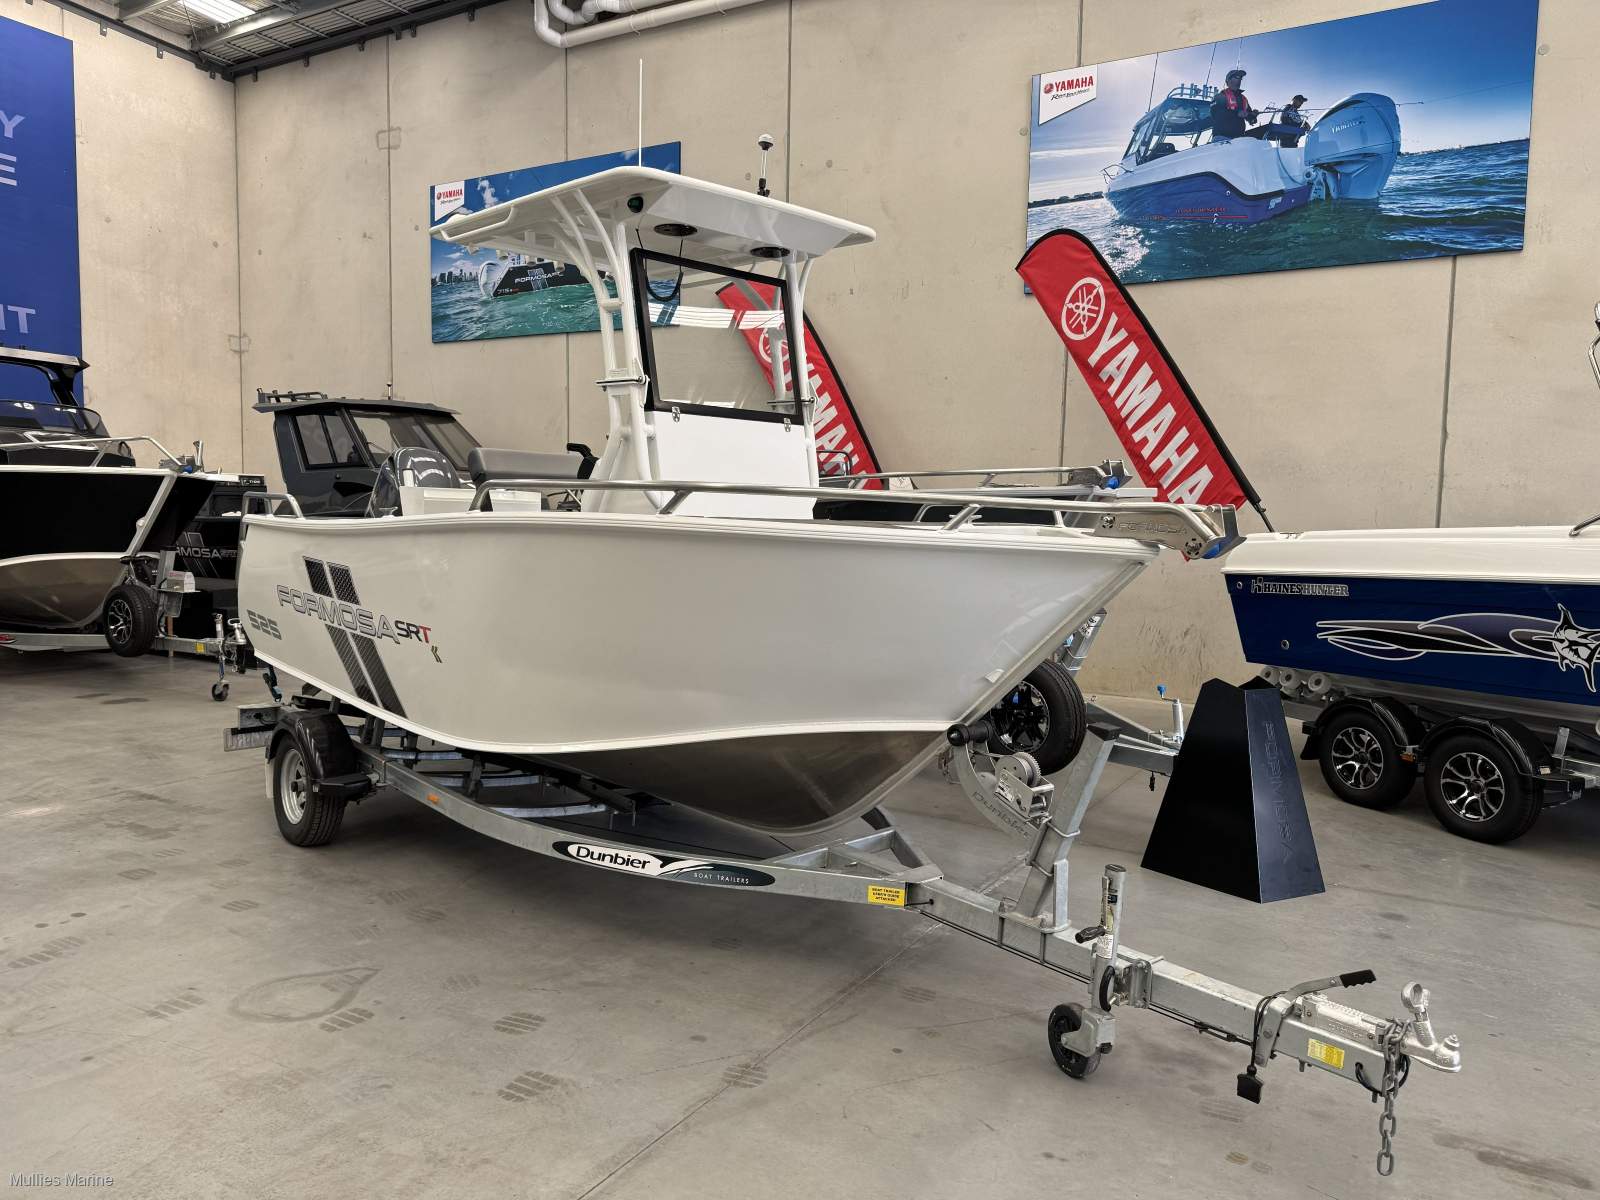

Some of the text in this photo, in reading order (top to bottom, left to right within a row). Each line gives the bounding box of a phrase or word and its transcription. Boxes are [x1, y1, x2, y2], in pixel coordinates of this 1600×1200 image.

[1055, 76, 1094, 92] YAMAHA
[442, 189, 463, 199] YAMAHA
[1088, 312, 1214, 504] YAMAHA
[247, 609, 282, 640] 525
[277, 585, 431, 644] FORMOSA SRT
[576, 845, 650, 869] Dunbier
[694, 872, 750, 884] BOAT TRAILERS
